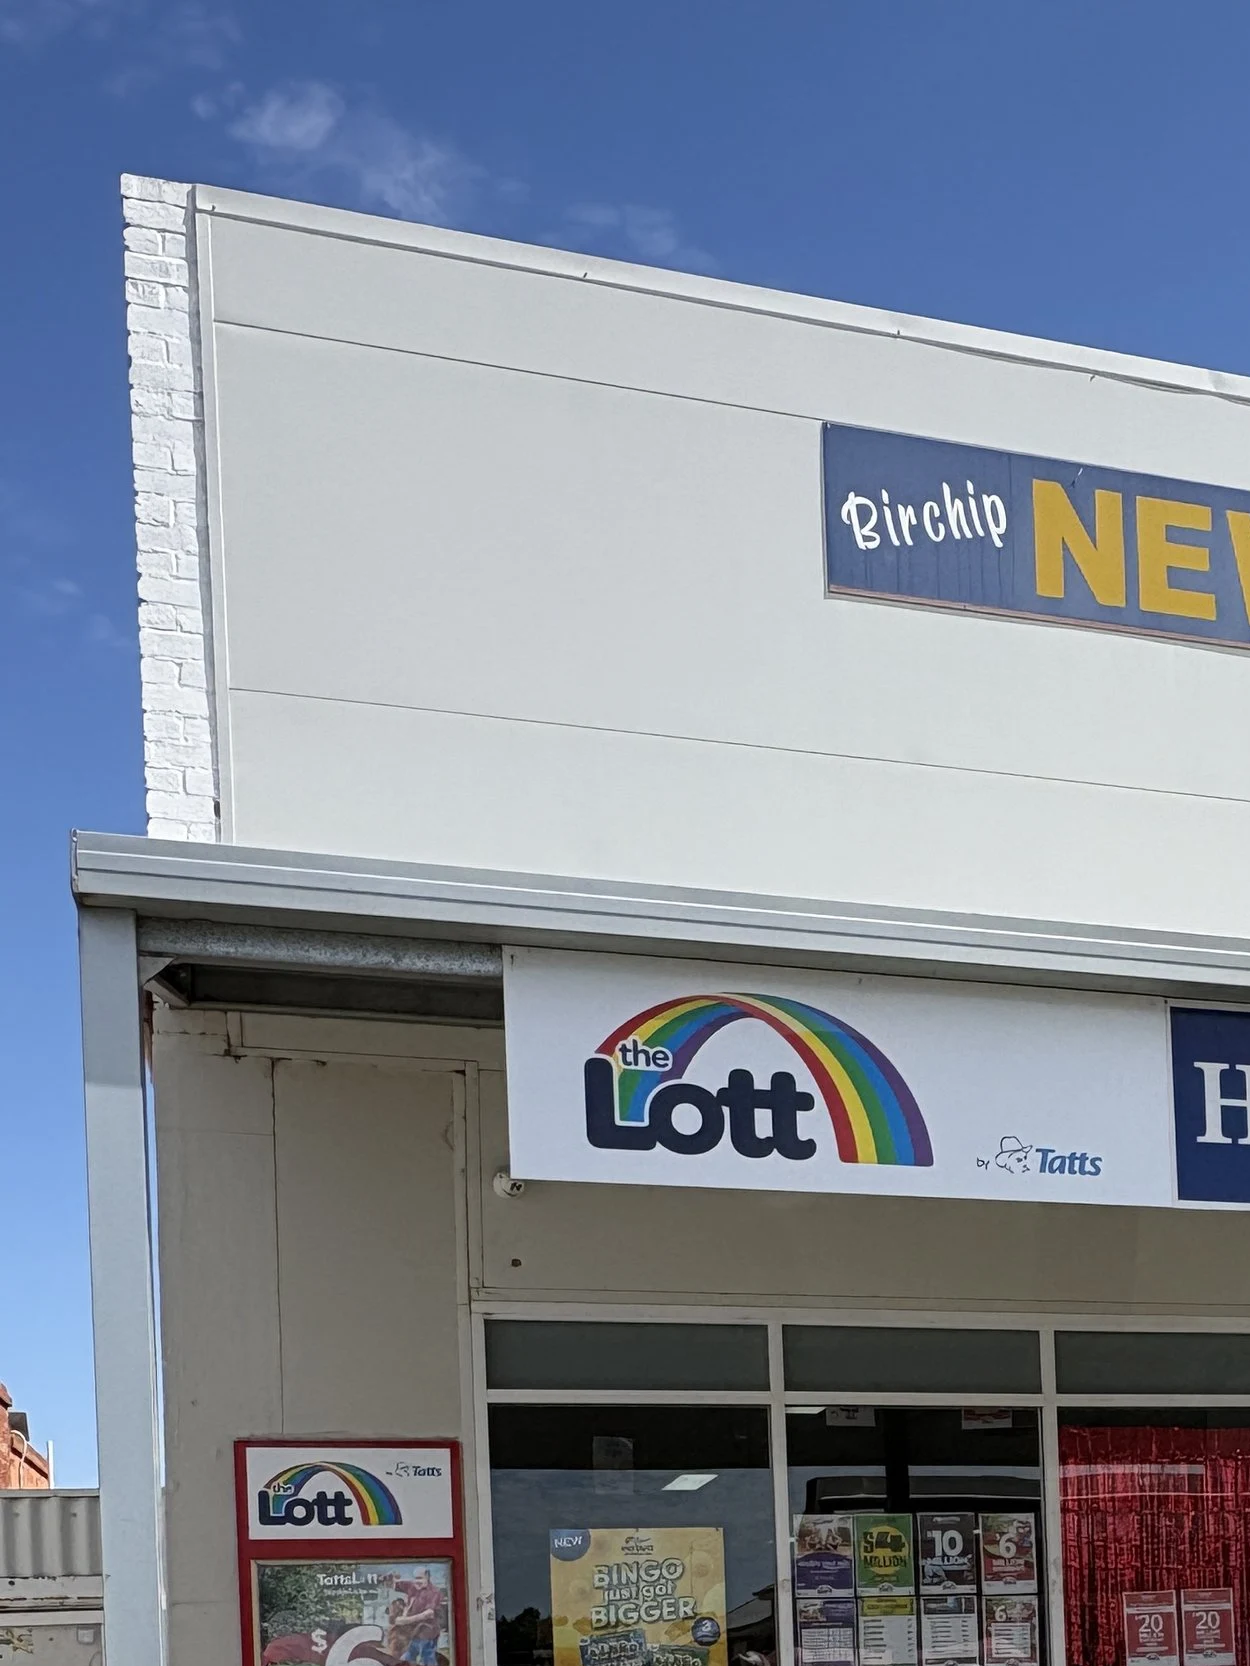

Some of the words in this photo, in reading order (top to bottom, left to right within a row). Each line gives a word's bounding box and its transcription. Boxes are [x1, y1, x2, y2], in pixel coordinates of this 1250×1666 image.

[842, 480, 1007, 550] Birchip
[618, 1040, 670, 1068] the
[584, 1056, 817, 1160] Lott
[976, 1157, 989, 1170] by
[1035, 1148, 1102, 1176] Tatts
[258, 1490, 353, 1526] Lott
[593, 1558, 684, 1588] BINGO
[591, 1596, 697, 1629] BIGGER
